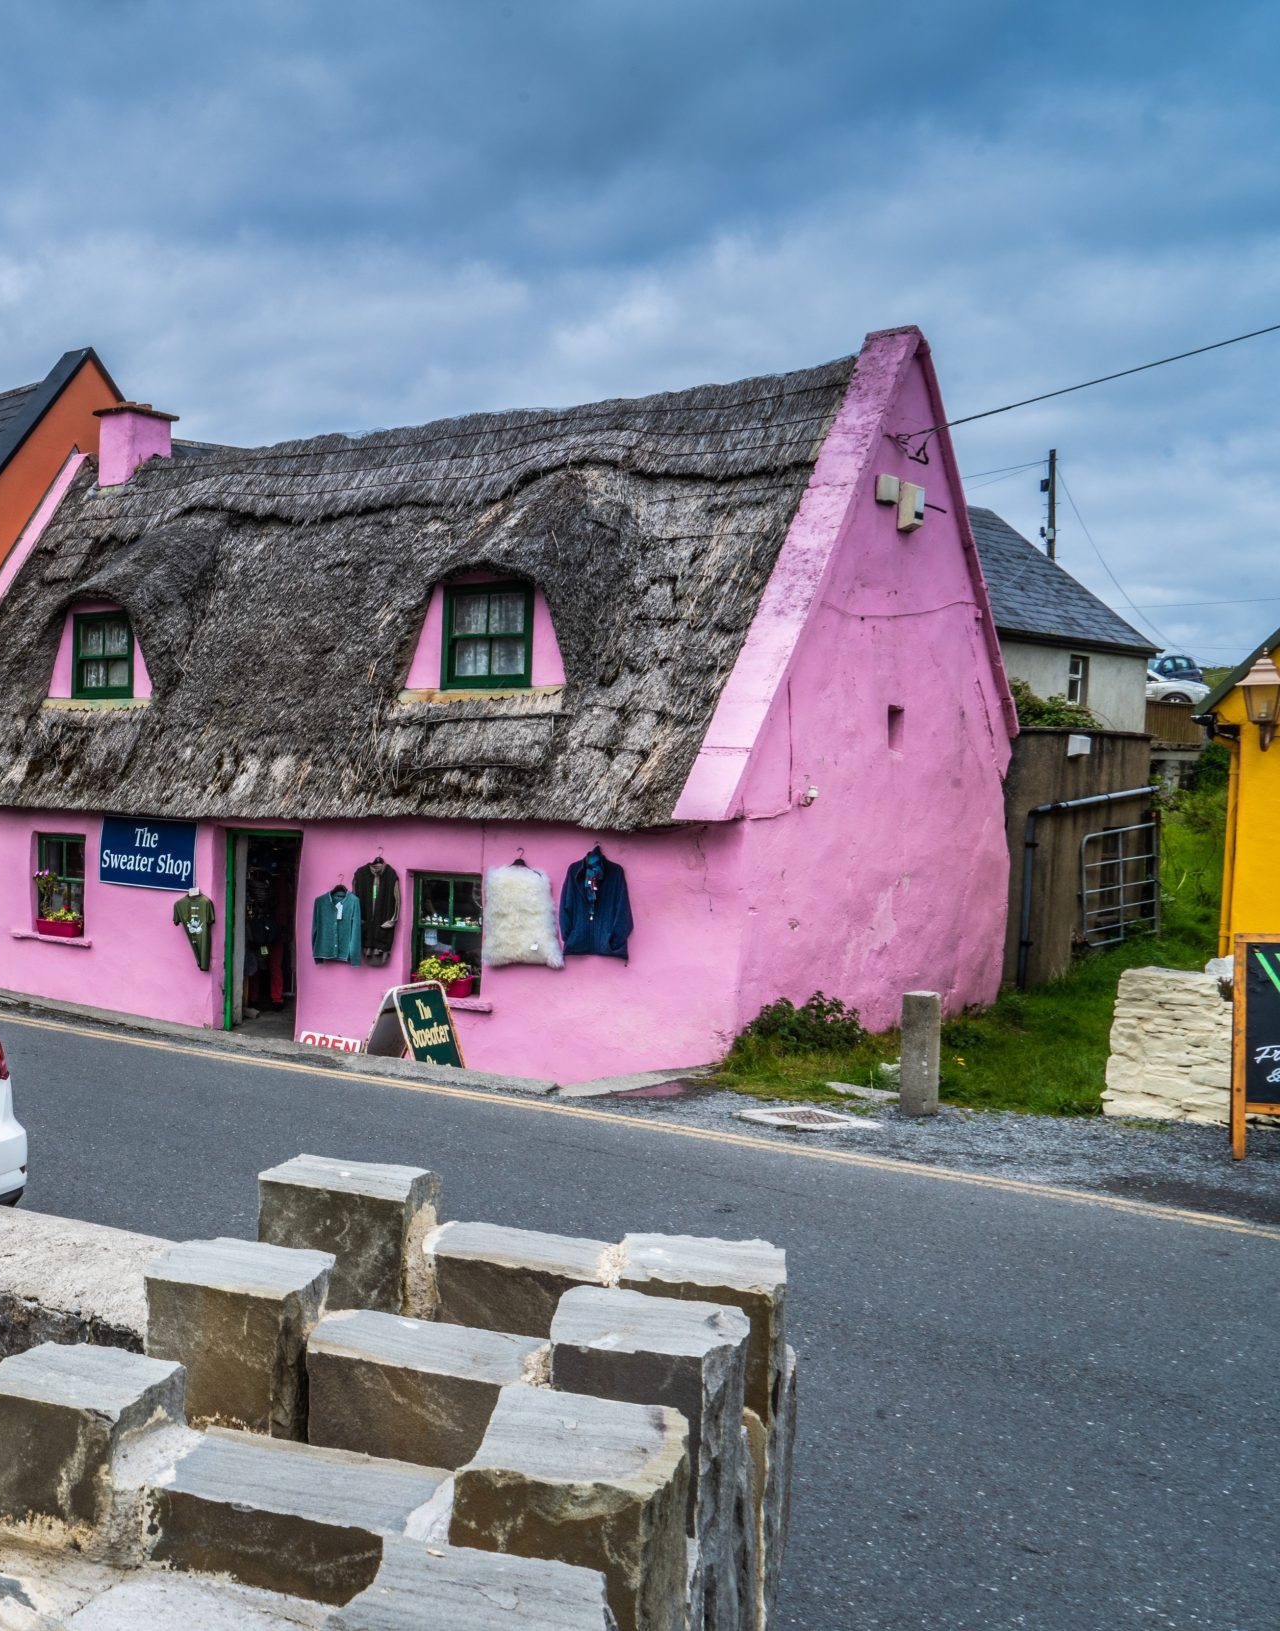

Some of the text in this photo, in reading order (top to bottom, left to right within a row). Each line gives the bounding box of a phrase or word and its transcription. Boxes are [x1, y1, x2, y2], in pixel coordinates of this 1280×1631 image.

[134, 827, 158, 848] The
[102, 849, 192, 881] Sweater Shop
[408, 1018, 449, 1048] Sweater
